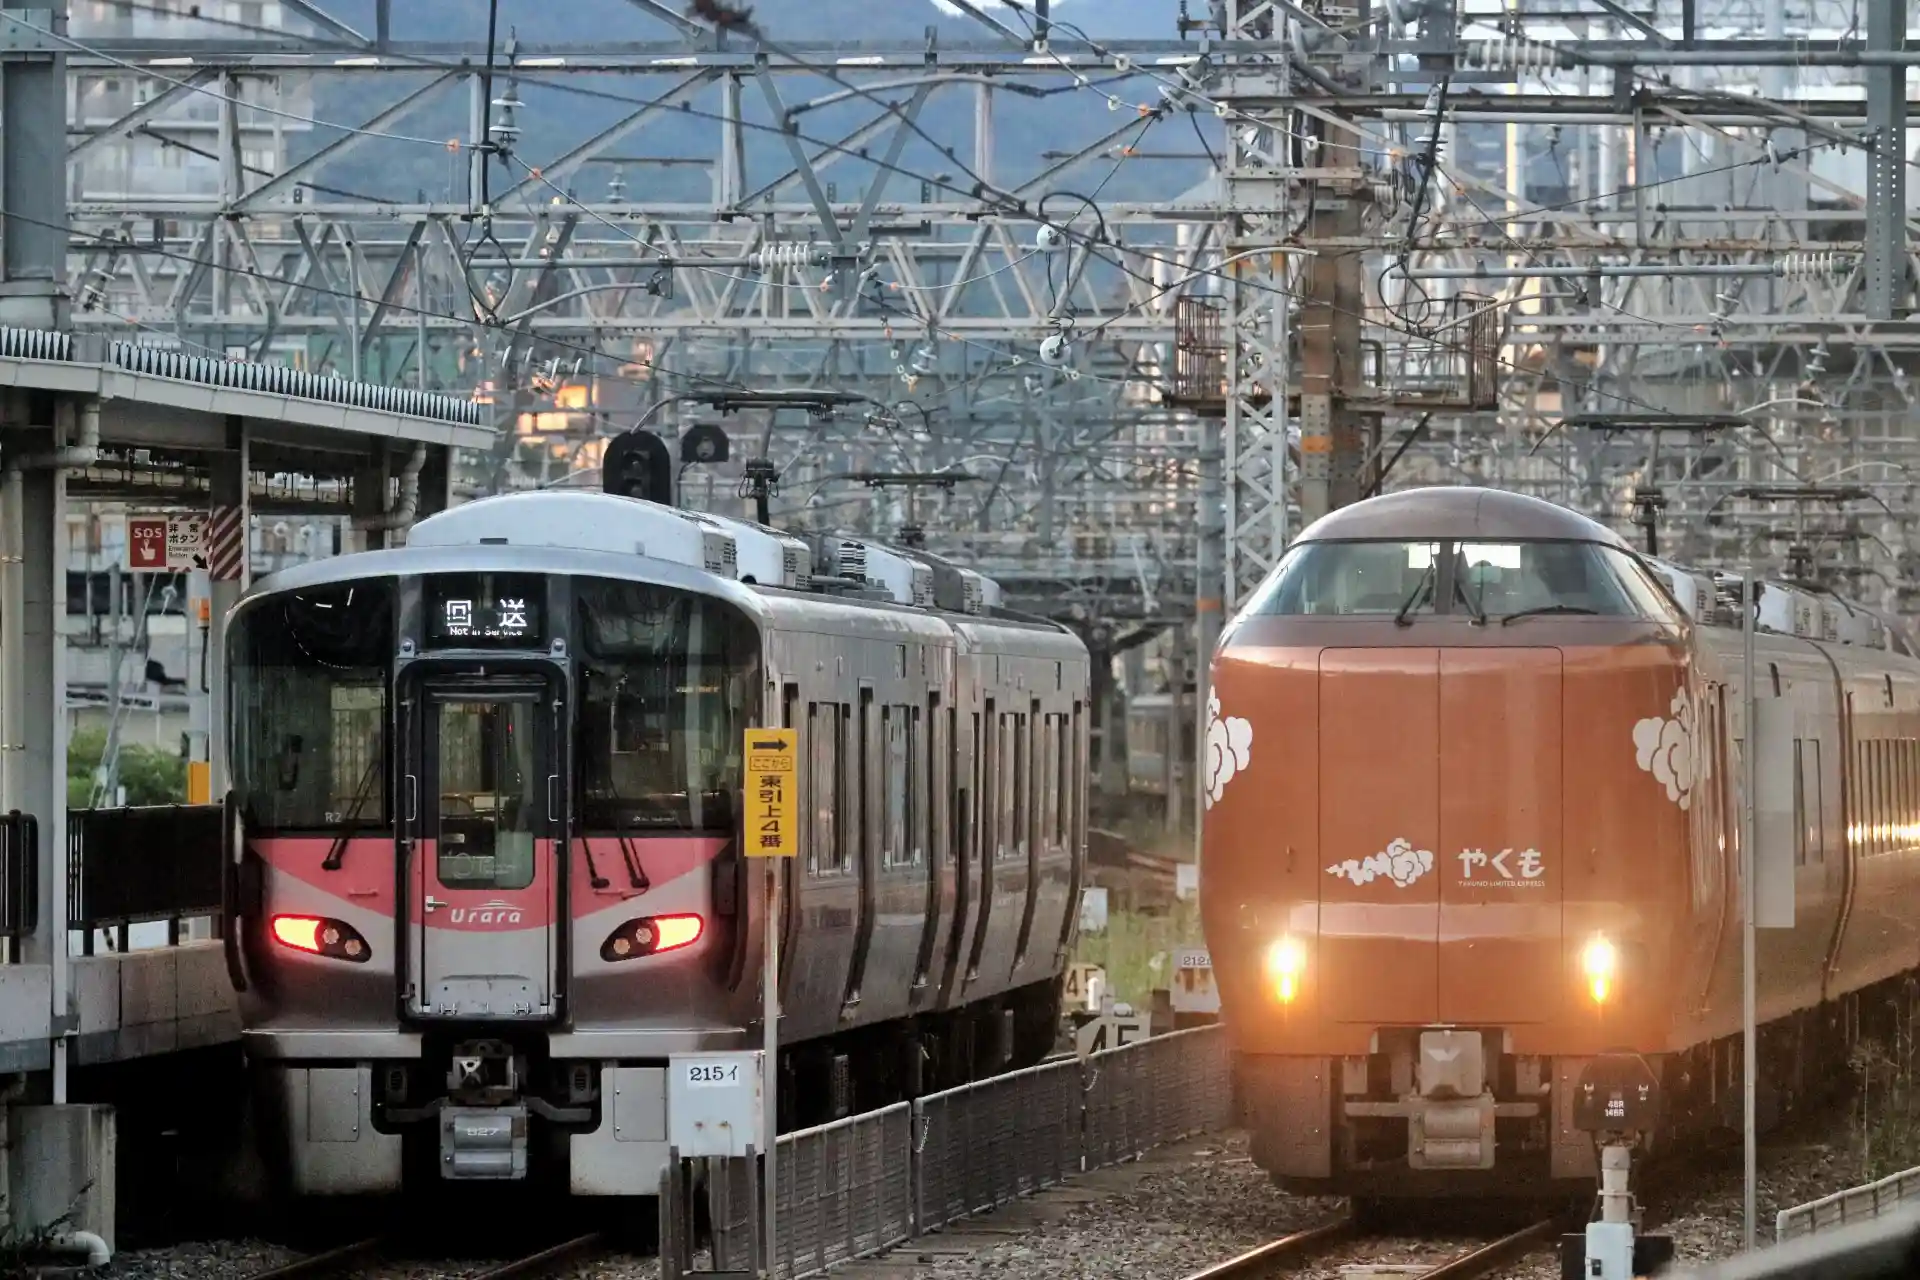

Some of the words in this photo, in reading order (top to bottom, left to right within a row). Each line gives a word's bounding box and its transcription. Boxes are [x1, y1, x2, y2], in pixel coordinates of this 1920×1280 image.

[133, 527, 163, 538] SOS
[168, 523, 199, 533] 非常
[168, 534, 199, 544] ボタン
[446, 598, 528, 627] 回送
[450, 627, 469, 636] Not
[752, 758, 790, 769] ここから
[324, 811, 342, 823] R2
[759, 775, 783, 848] 東引上4番
[1457, 847, 1546, 879] やくも
[450, 908, 522, 924] Urara
